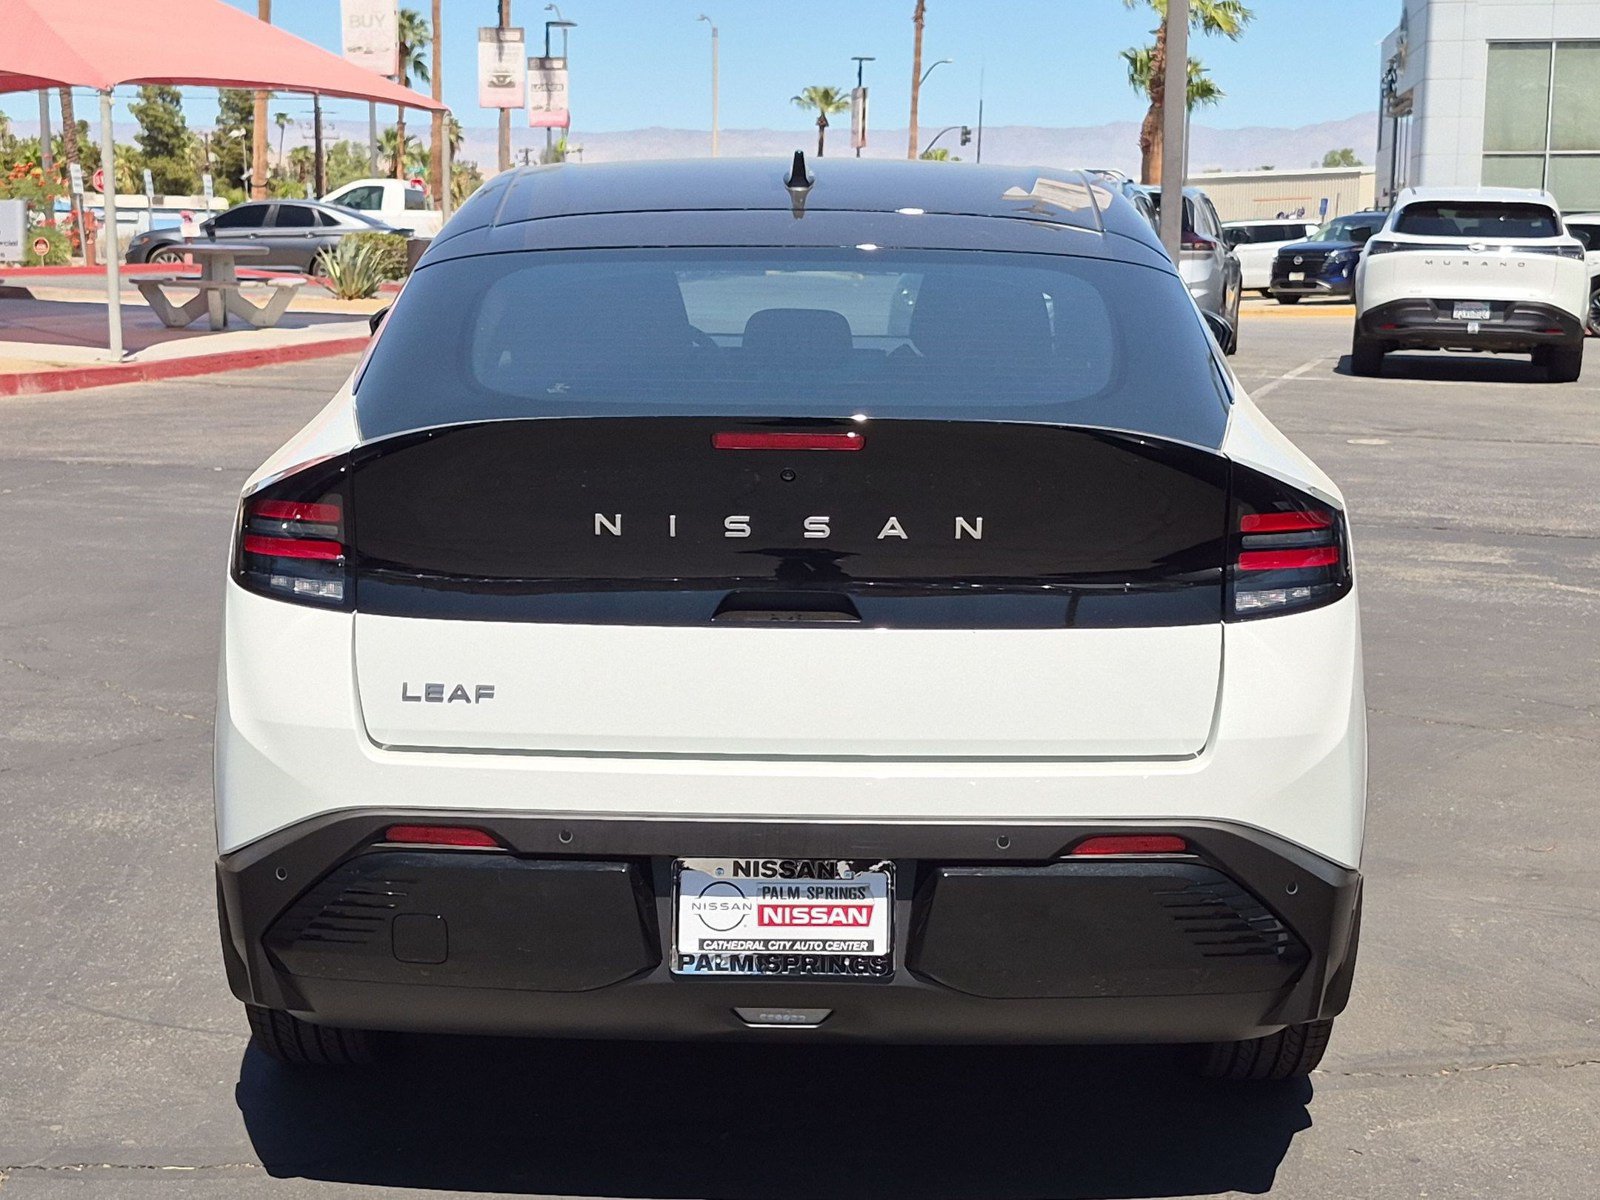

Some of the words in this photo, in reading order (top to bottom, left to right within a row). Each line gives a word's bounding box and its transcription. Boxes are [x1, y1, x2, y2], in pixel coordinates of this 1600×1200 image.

[349, 14, 386, 29] BUY
[1424, 260, 1527, 268] MURANO
[593, 512, 984, 541] NISSAN
[401, 681, 496, 705] LEAF
[732, 859, 838, 880] NISSAN
[761, 885, 802, 900] PALM
[806, 885, 867, 900] SPRINGS
[691, 902, 753, 911] NISSAN
[762, 906, 869, 925] NISSAN
[702, 939, 767, 951] CATHEDRAL
[767, 939, 793, 951] CITY
[793, 940, 825, 951] AUTO
[825, 940, 869, 952] CENTER
[678, 953, 756, 974] PALM
[762, 954, 891, 976] SPRINGS
